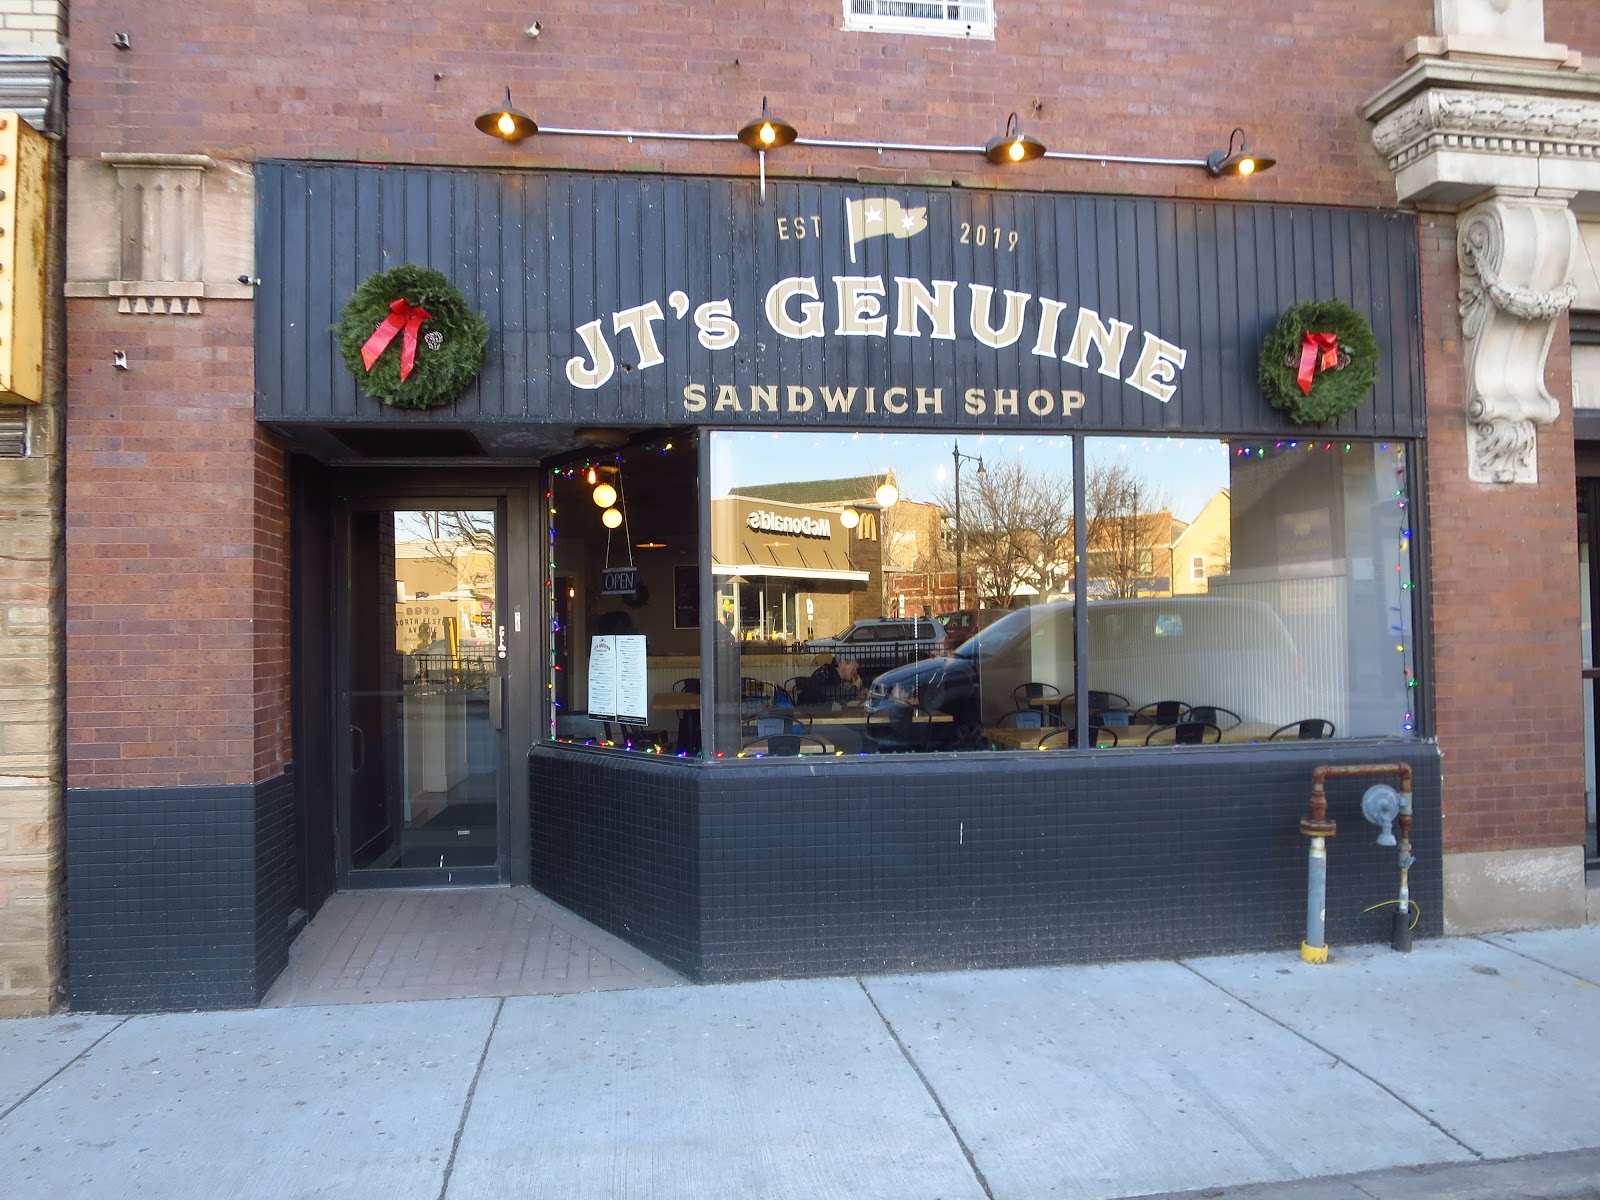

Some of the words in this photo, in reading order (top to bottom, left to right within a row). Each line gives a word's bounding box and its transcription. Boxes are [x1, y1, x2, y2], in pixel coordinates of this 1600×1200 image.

[777, 215, 821, 240] EST
[959, 221, 1019, 252] 2019
[764, 275, 1187, 403] GENUINE
[683, 384, 943, 415] SANDWICH
[964, 388, 1086, 416] SHOP
[605, 572, 634, 590] OPEN
